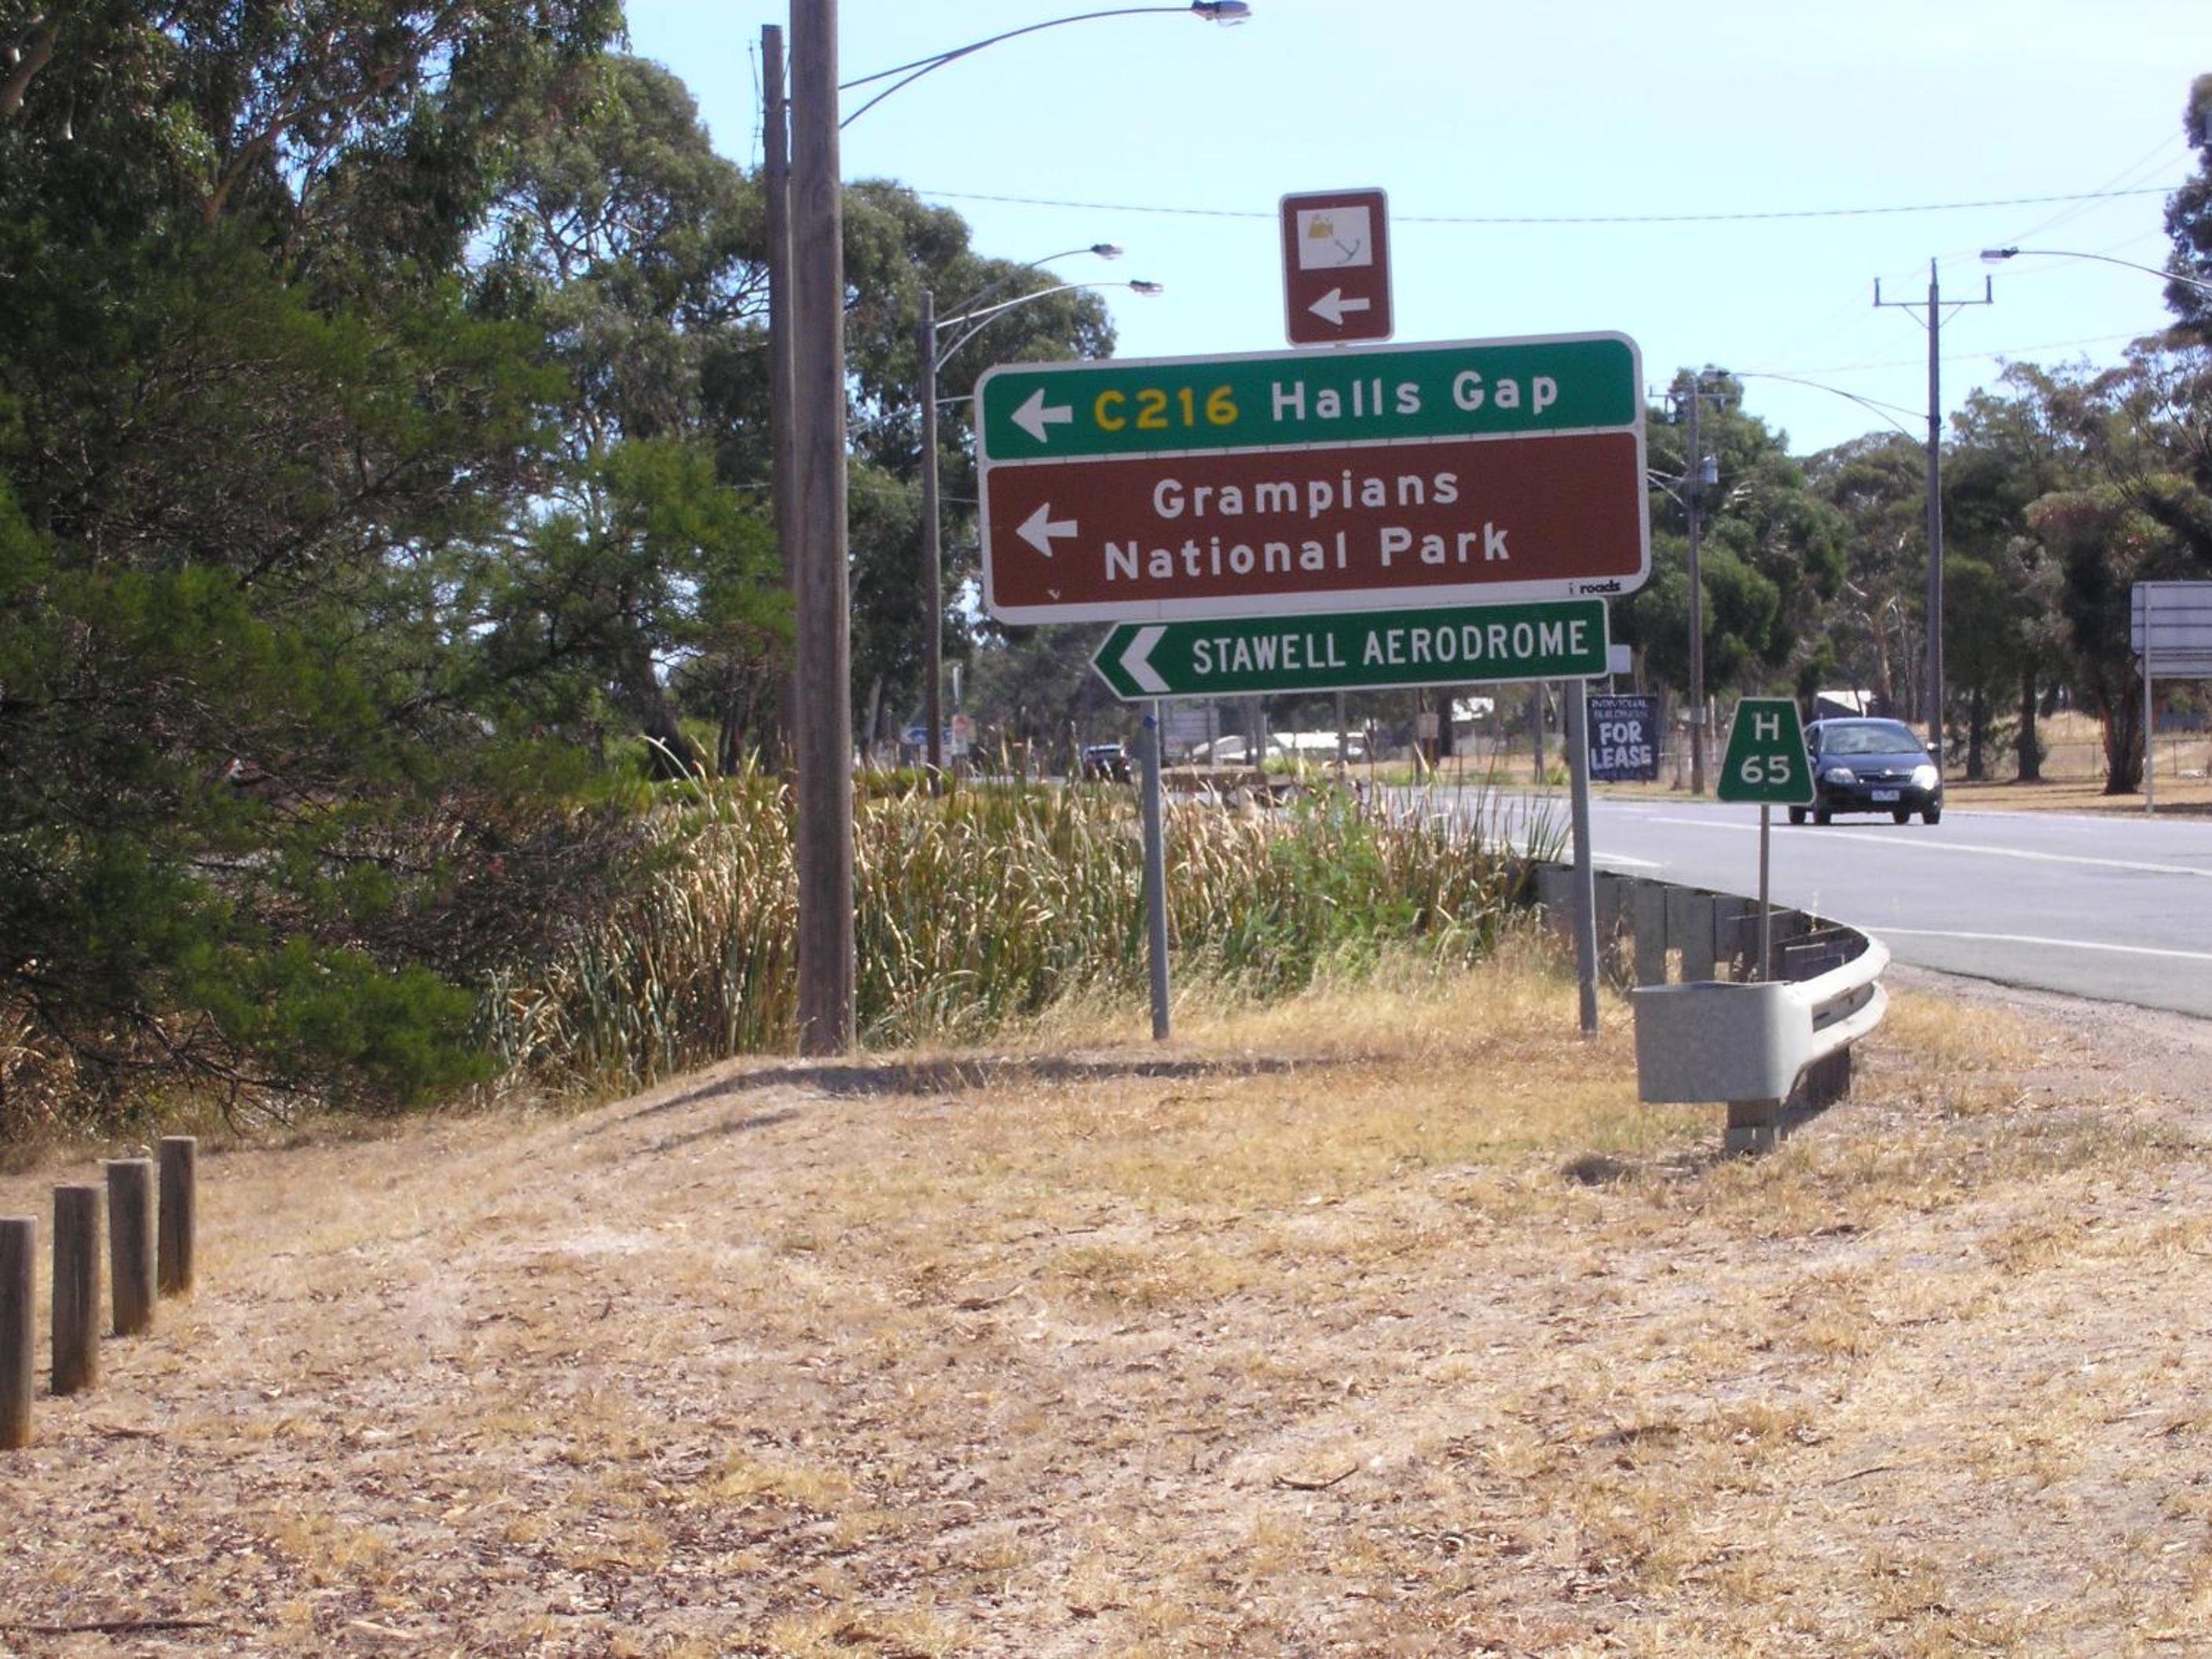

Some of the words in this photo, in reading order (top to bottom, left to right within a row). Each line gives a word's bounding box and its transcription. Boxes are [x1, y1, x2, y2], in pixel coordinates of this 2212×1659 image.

[1093, 383, 1239, 432] C216
[1271, 377, 1423, 422] Halls
[1452, 369, 1558, 416] Gap
[1152, 468, 1459, 519] Grampians
[1104, 529, 1347, 581] National
[1380, 522, 1511, 567] Park
[1580, 579, 1621, 594] roads
[1192, 632, 1347, 675] STAWELL
[1362, 619, 1590, 665] AERODROME
[1599, 720, 1643, 745] FOR
[1754, 712, 1779, 742] H
[1591, 745, 1652, 771] LEASE
[1740, 754, 1791, 785] 65
